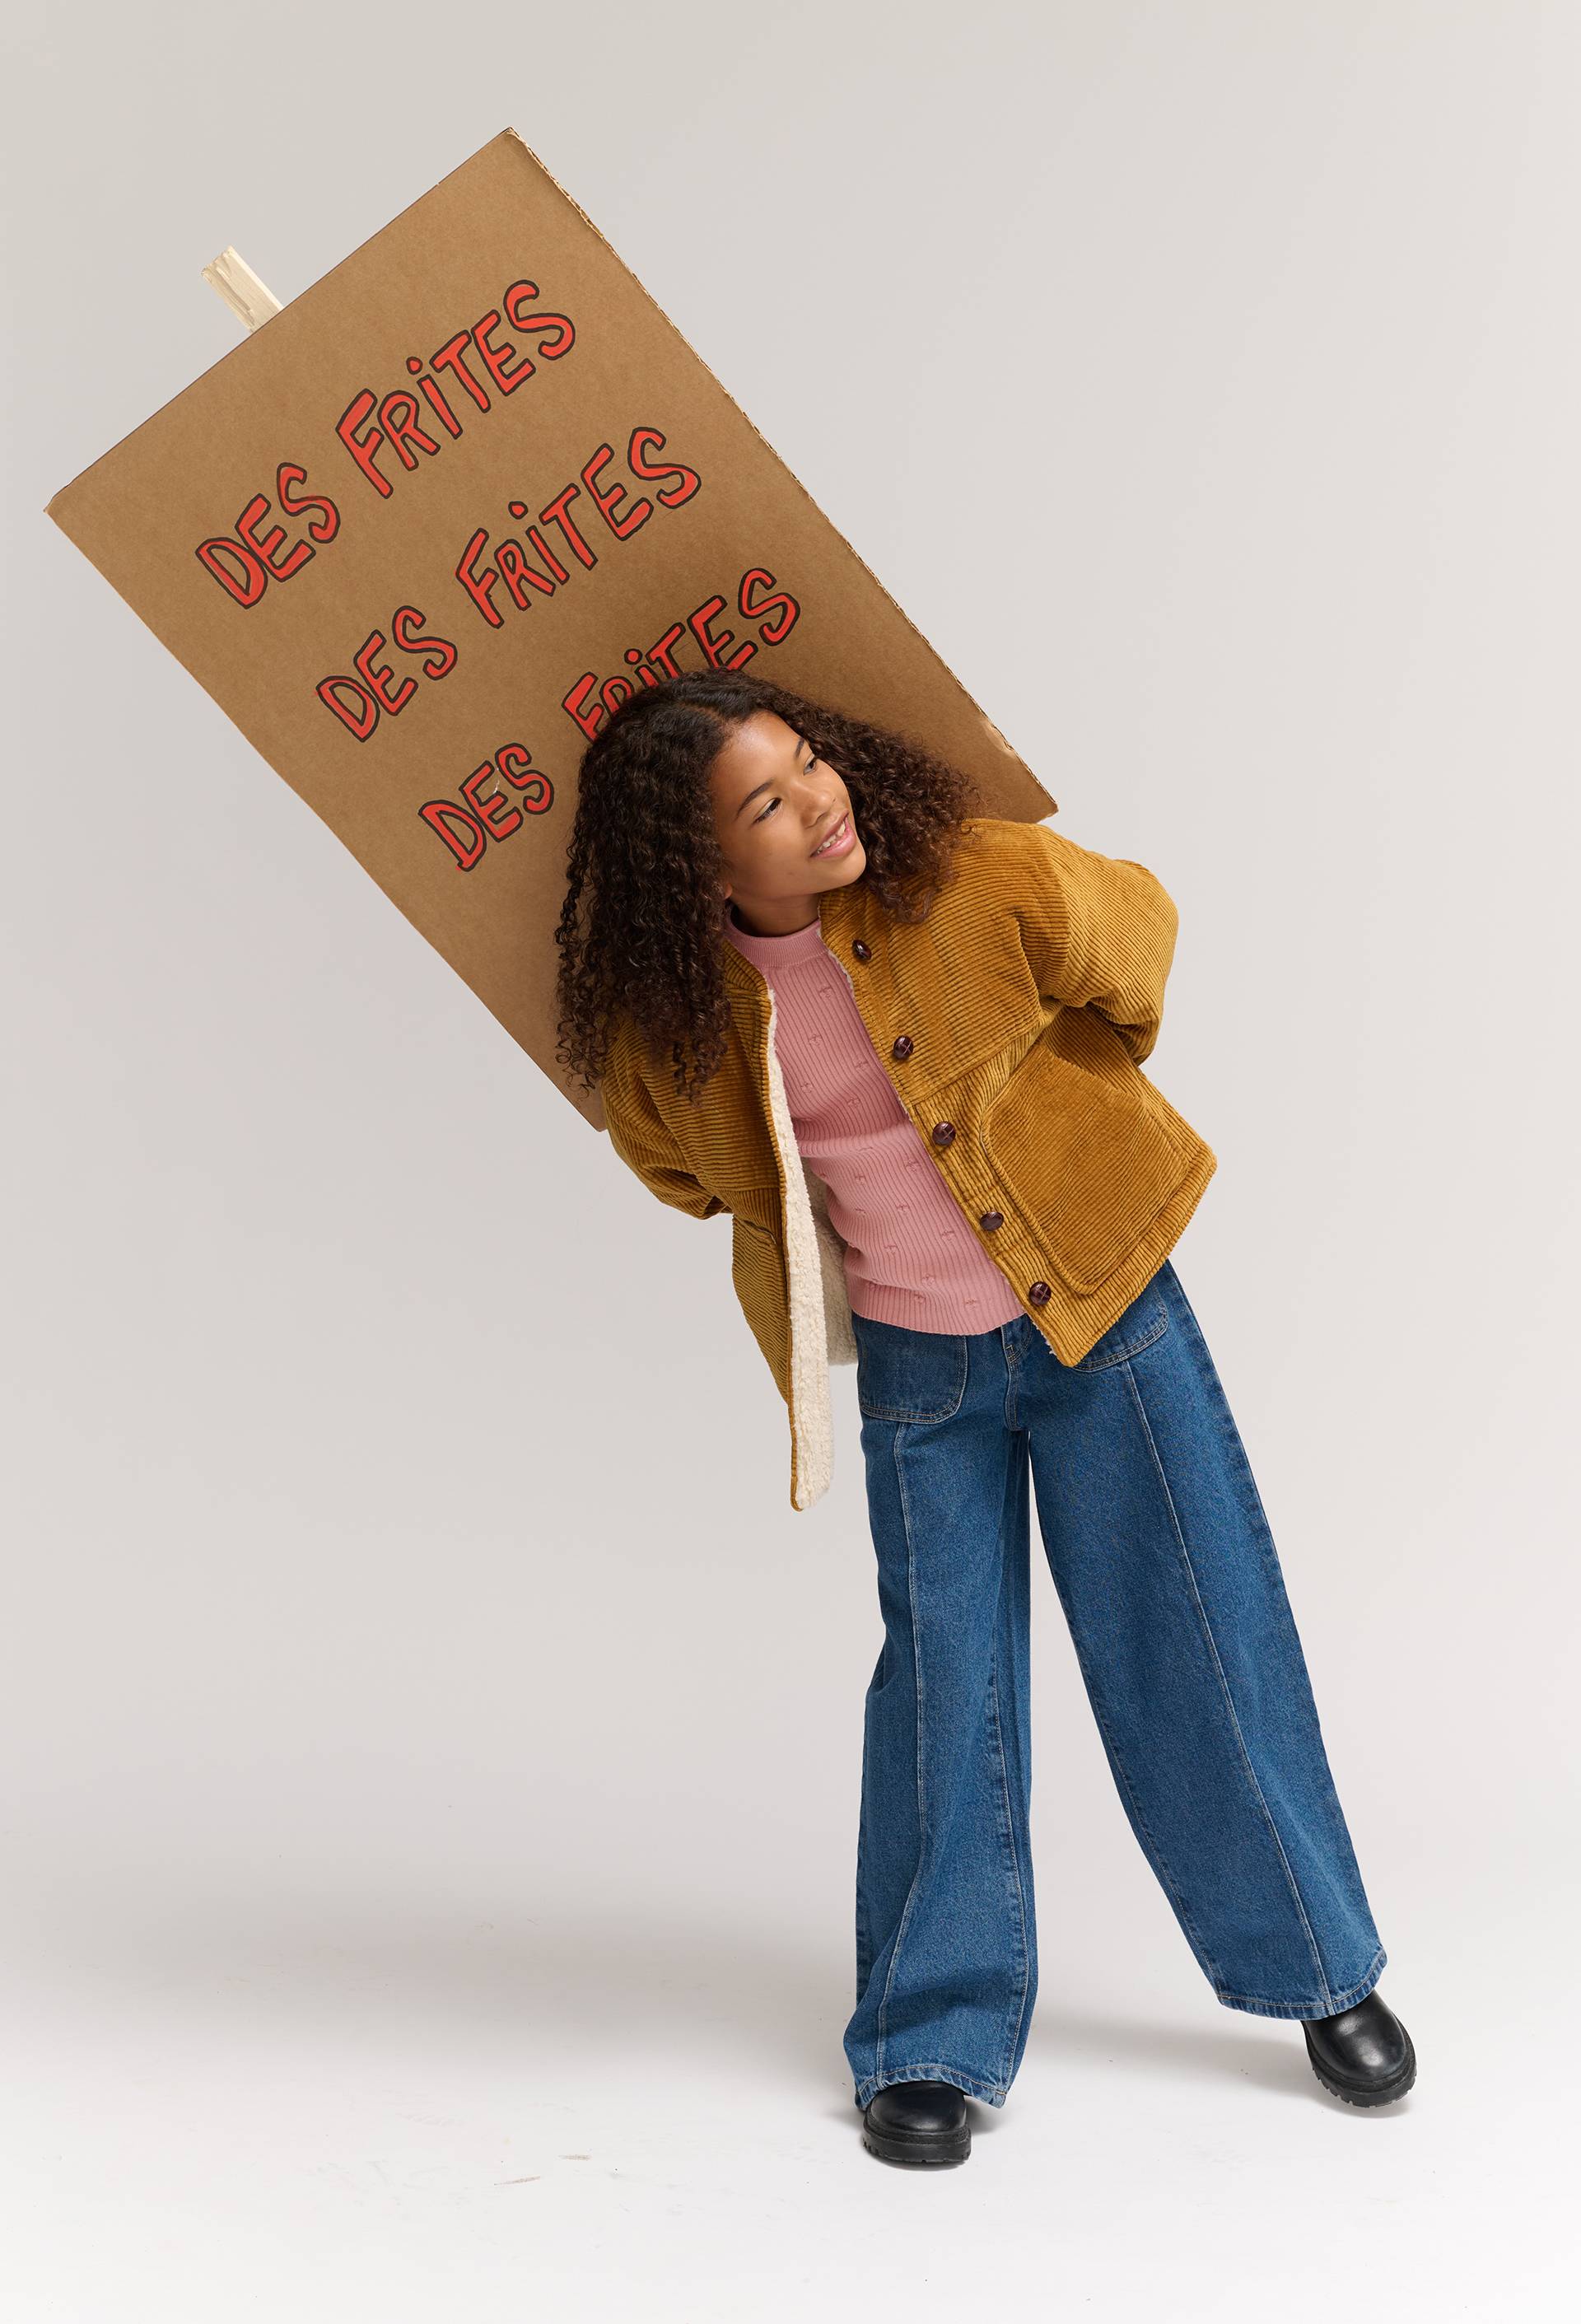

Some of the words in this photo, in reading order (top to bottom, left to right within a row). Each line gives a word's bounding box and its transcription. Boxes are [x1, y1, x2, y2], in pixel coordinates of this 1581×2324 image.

[195, 463, 340, 609] DES
[316, 606, 458, 742] DES
[418, 743, 554, 871] DES
